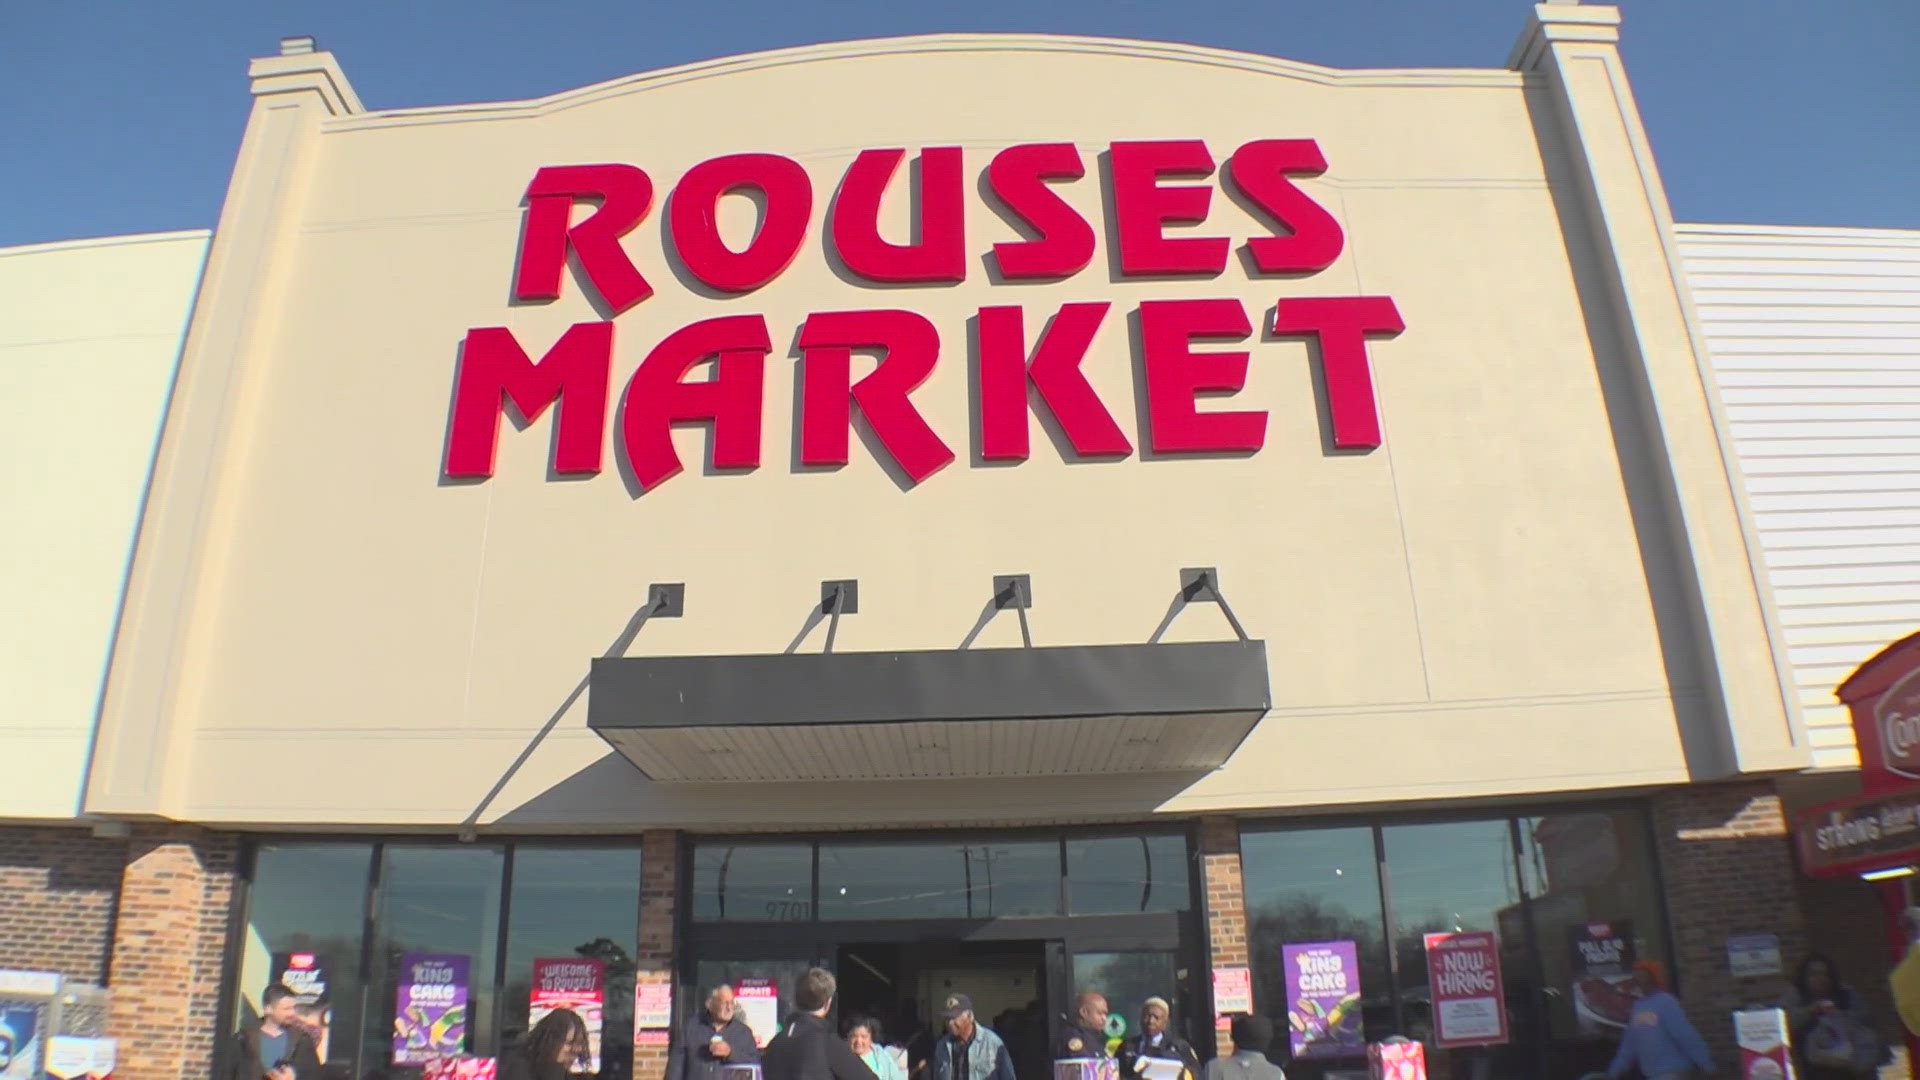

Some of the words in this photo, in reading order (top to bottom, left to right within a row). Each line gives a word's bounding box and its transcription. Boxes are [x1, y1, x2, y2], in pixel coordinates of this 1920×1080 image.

[516, 138, 1345, 314] ROUSES
[443, 295, 1405, 490] MARKET
[766, 901, 809, 920] 9701
[545, 964, 593, 977] WELCOME
[1300, 955, 1342, 974] KING
[1443, 951, 1484, 972] NOW
[413, 967, 455, 983] KING
[1299, 972, 1347, 991] CAKE
[1437, 970, 1496, 995] HIRING
[409, 983, 456, 1000] CAKE
[739, 986, 771, 997] UPDATE
